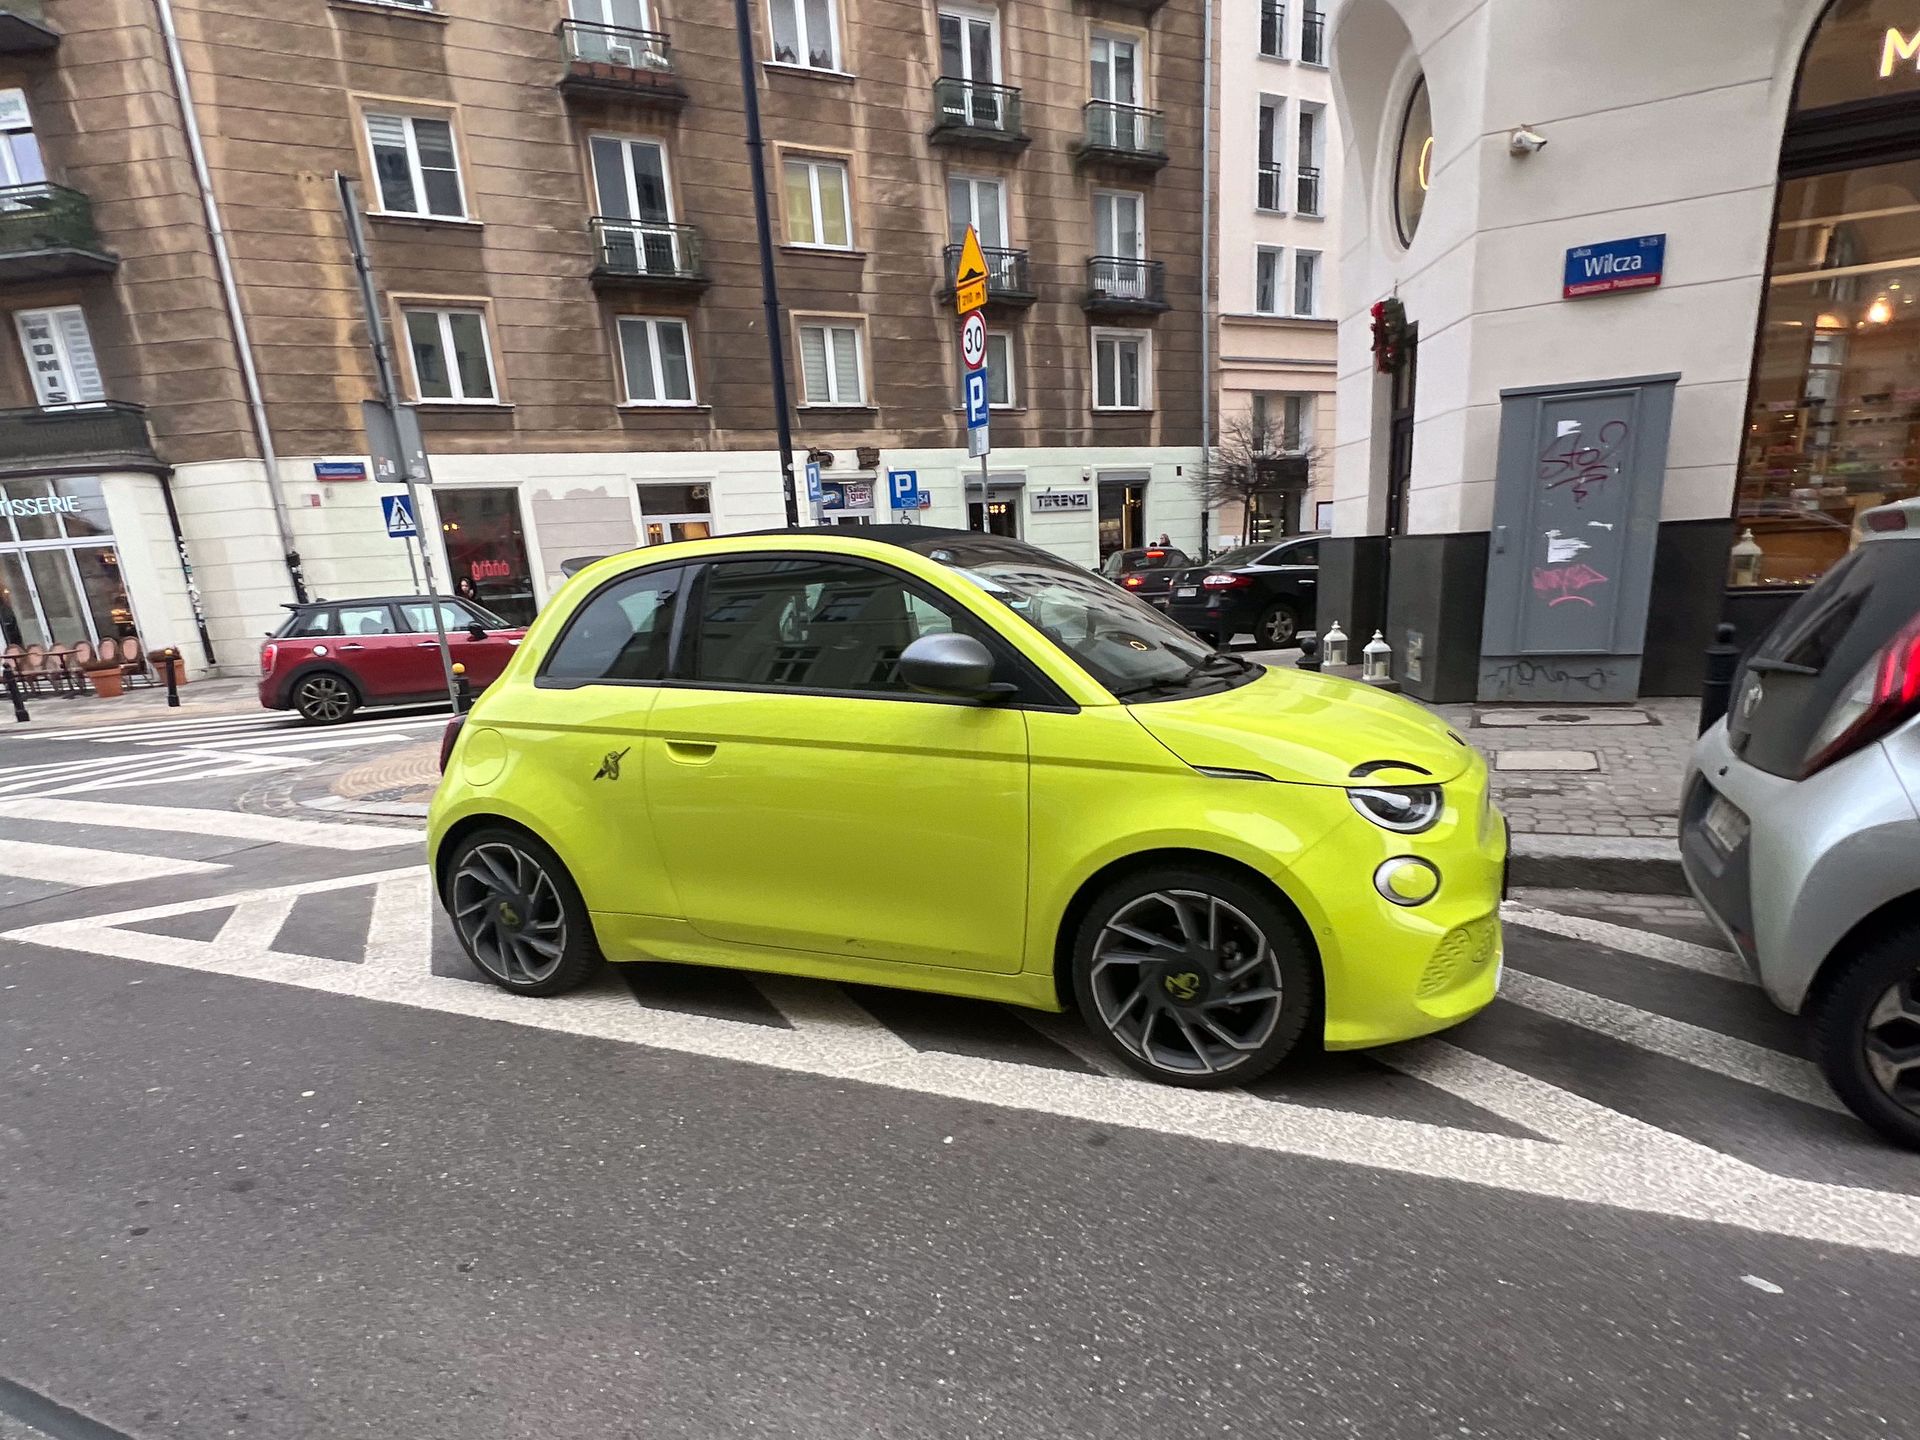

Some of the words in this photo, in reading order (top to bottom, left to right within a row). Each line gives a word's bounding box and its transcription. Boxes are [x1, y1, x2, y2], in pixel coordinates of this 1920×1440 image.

[1584, 253, 1642, 277] Wilcza
[965, 326, 983, 354] 30
[969, 376, 984, 422] P
[894, 474, 912, 498] P
